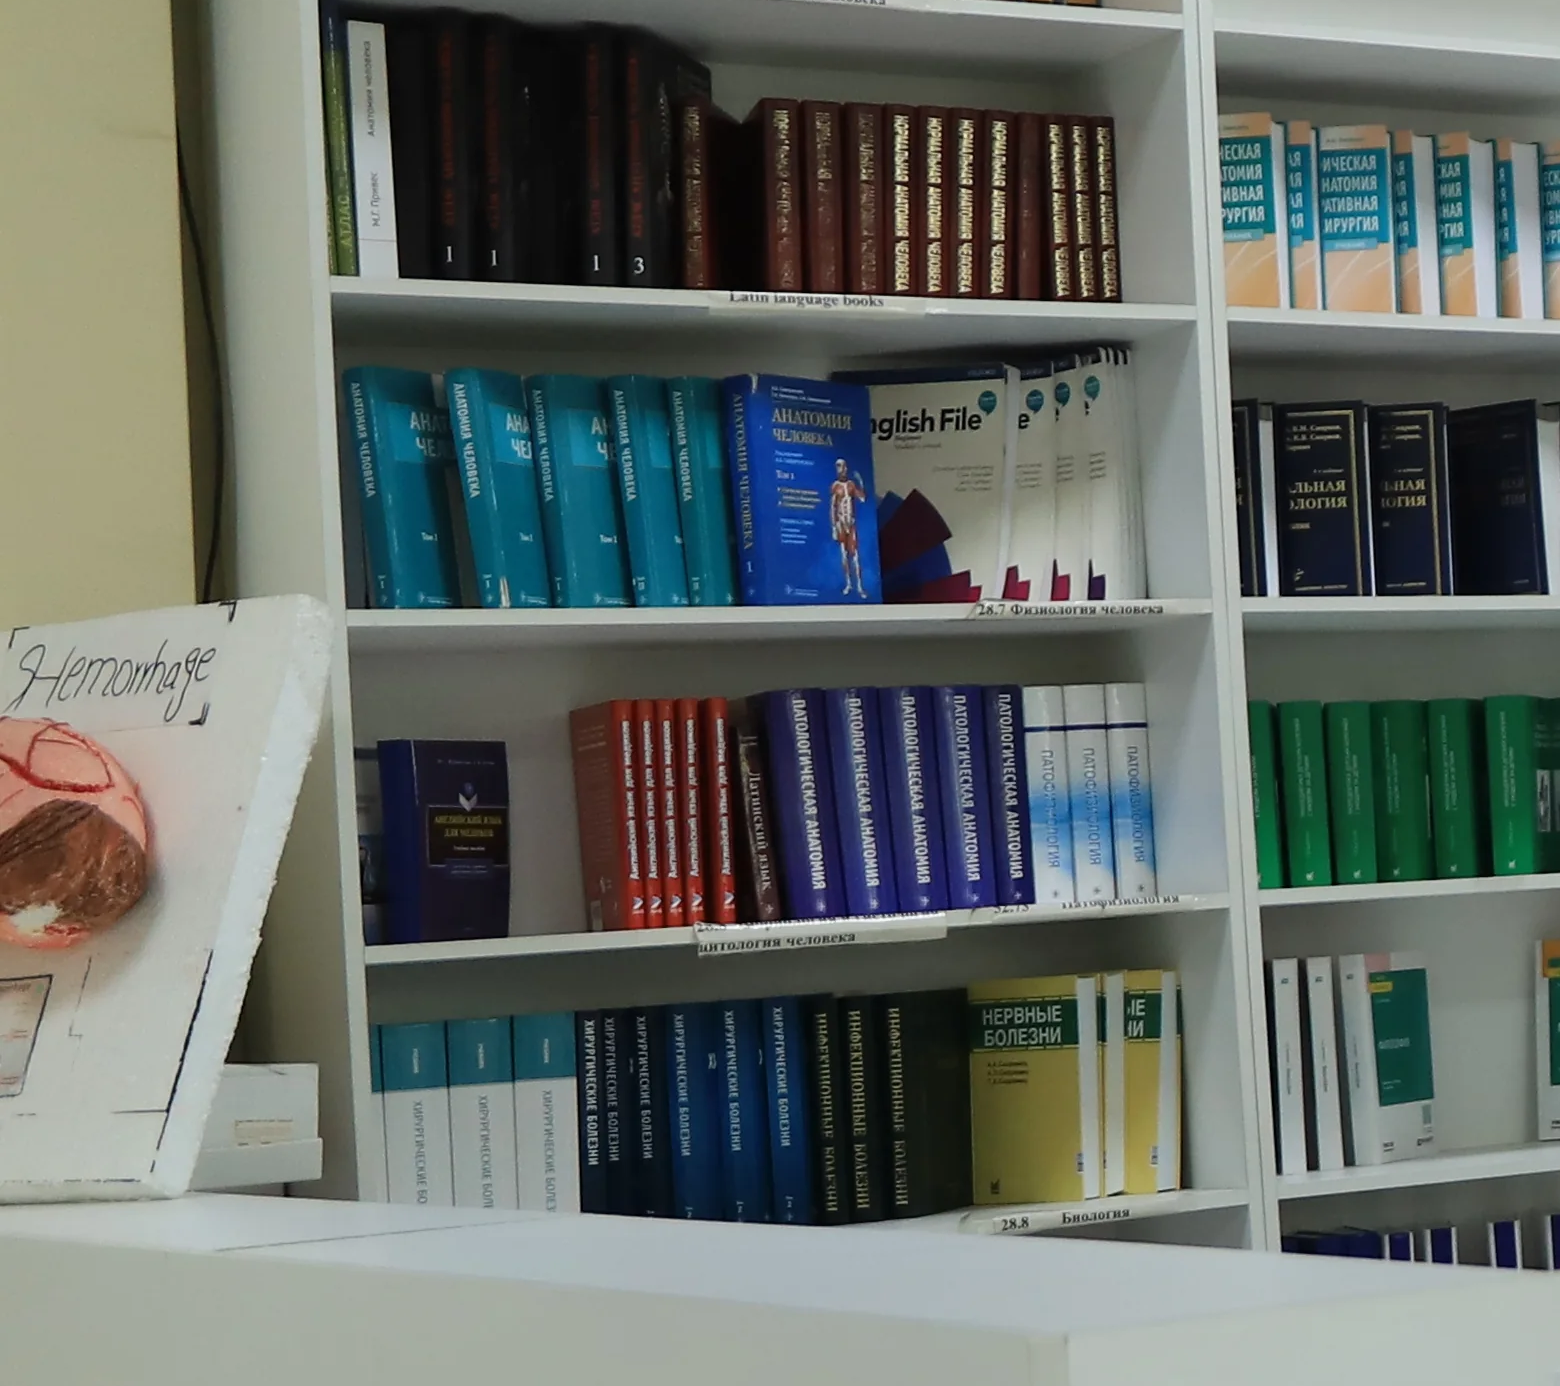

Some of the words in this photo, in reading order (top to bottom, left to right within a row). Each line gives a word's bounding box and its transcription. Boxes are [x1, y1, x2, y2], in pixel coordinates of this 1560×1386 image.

[366, 88, 376, 138] Анатомия
[1322, 175, 1377, 191] НАТОМИЯ
[1323, 215, 1379, 232] ИРУРГИЯ
[633, 256, 645, 274] 3
[843, 295, 884, 307] books
[452, 383, 472, 441] АНАТОМИЯ
[672, 391, 688, 446] АНАТОМИЯ
[771, 408, 852, 432] АНАТОМИЯ
[772, 425, 834, 448] ЧЕЛОВЕКА
[940, 407, 982, 432] File
[350, 382, 367, 441] АНАТОМИЯ
[359, 442, 376, 498] ЧЕЛОВЕКА
[613, 390, 629, 445] АНАТОМИЯ
[621, 446, 638, 503] ЧЕЛОВЕКА
[461, 442, 481, 499] ЧЕЛОВЕКА
[678, 447, 693, 503] ЧЕЛОВЕКА
[731, 393, 748, 473] АНАТОМИЯ
[740, 474, 755, 551] ЧЕЛОВЕКА
[978, 603, 1006, 616] 28.7
[1011, 603, 1096, 616] Физиология
[1101, 604, 1164, 615] человека
[902, 695, 925, 813] ПАТОЛОГИЧЕСКАЯ
[953, 694, 975, 810] ПАТОЛОГИЧЕСКАЯ
[998, 693, 1018, 808] ПАТОЛОГИЧЕСКАЯ
[792, 698, 817, 816] ПАТОЛОГИЧЕСКАЯ
[806, 817, 827, 891] АНАТОМИЯ
[848, 697, 872, 815] ПАТОЛОГИЧЕСКАЯ
[860, 816, 880, 887] АНАТОМИЯ
[911, 814, 931, 884] АНАТОМИЯ
[962, 812, 980, 882] АНАТОМИЯ
[1006, 809, 1024, 880] АНАТОМИЯ
[787, 932, 856, 946] человека
[982, 1004, 1062, 1026] НЕРВНЫЕ
[984, 1026, 1062, 1048] БОЛЕЗНИ
[583, 1019, 598, 1112] ХИРУРГИЧЕСКИЕ
[673, 1014, 689, 1106] ХИРУРГИЧЕСКИЕ
[724, 1010, 739, 1103] ХИРУРГИЧЕСКИЕ
[773, 1006, 789, 1098] ХИРУРГИЧЕСКИЕ
[587, 1114, 599, 1166] БОЛЕЗНИ
[679, 1107, 691, 1157] БОЛЕЗНИ
[729, 1104, 742, 1152] БОЛЕЗНИ
[779, 1099, 791, 1147] БОЛЕЗНИ
[1002, 1216, 1030, 1231] 28.8
[1062, 1207, 1130, 1224] Биология
